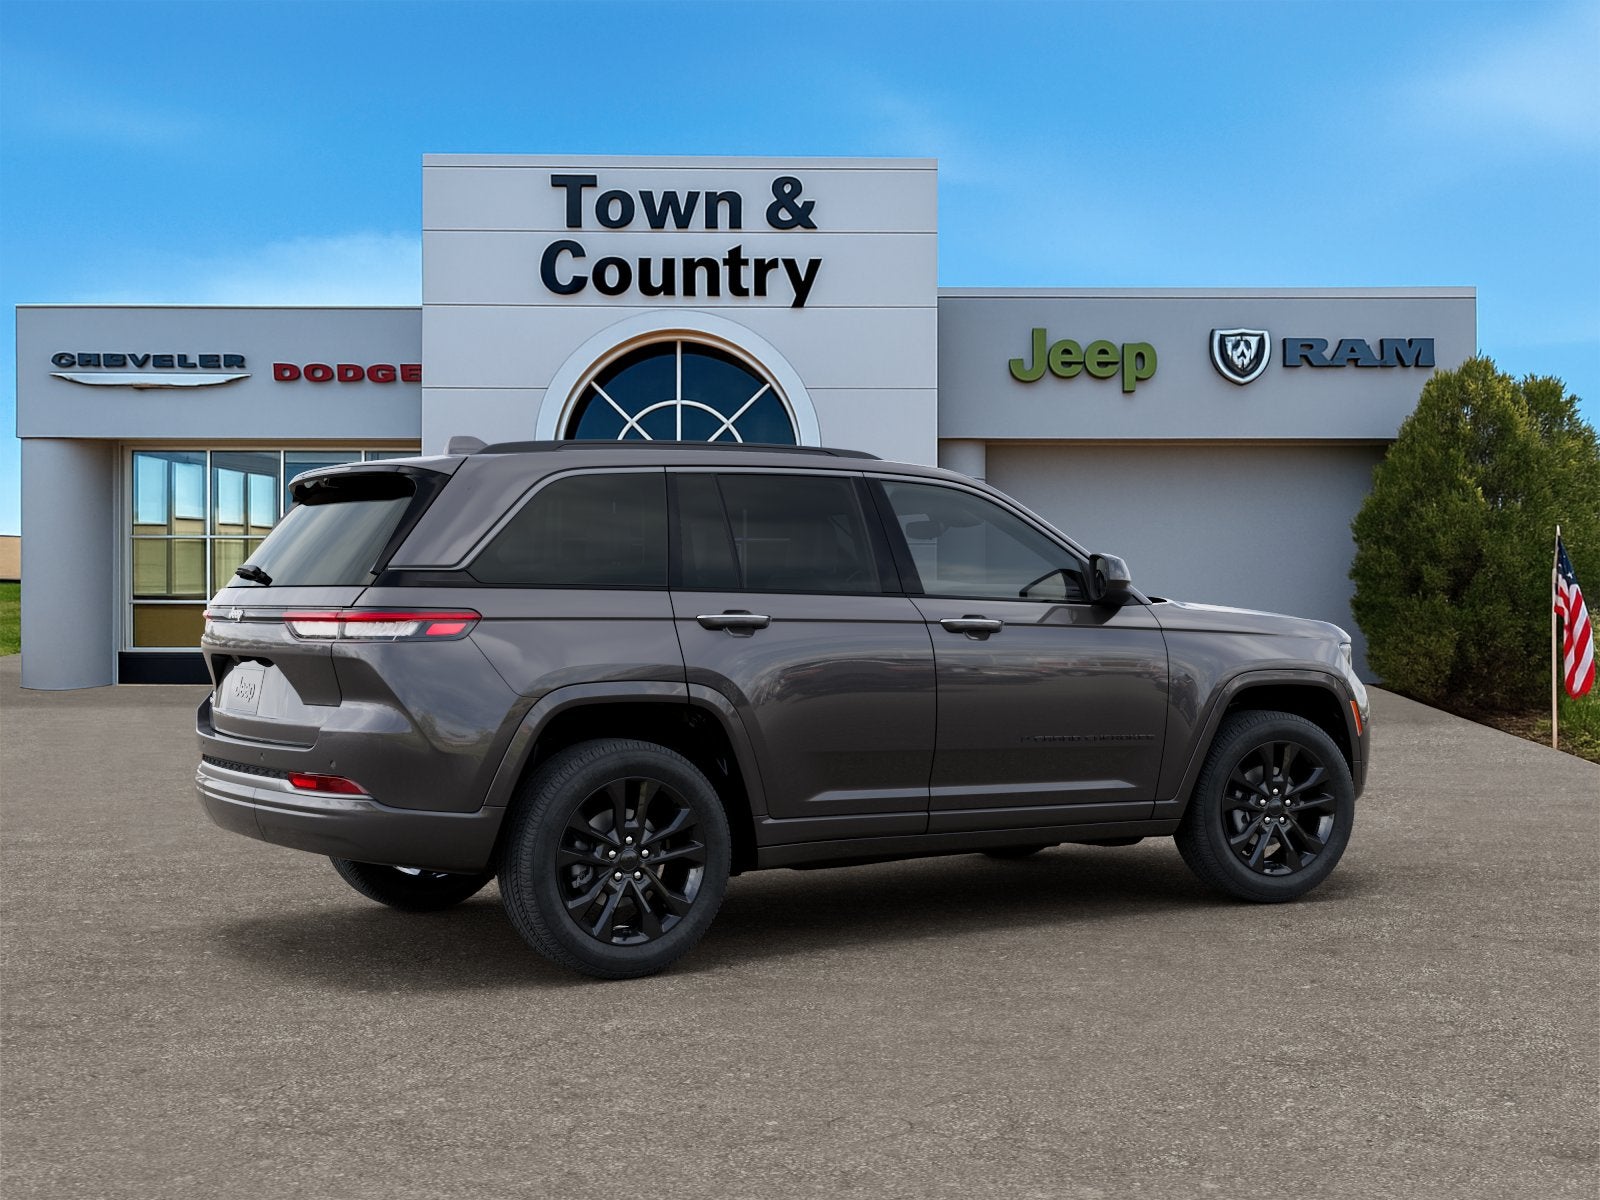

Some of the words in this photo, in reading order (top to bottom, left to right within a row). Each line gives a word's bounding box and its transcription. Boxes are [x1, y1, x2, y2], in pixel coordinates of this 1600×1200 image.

[551, 174, 742, 229] Town
[766, 176, 818, 229] &
[540, 239, 822, 308] Country
[273, 362, 422, 383] DODGE
[1009, 328, 1157, 392] Jeep
[1282, 337, 1436, 368] RAM
